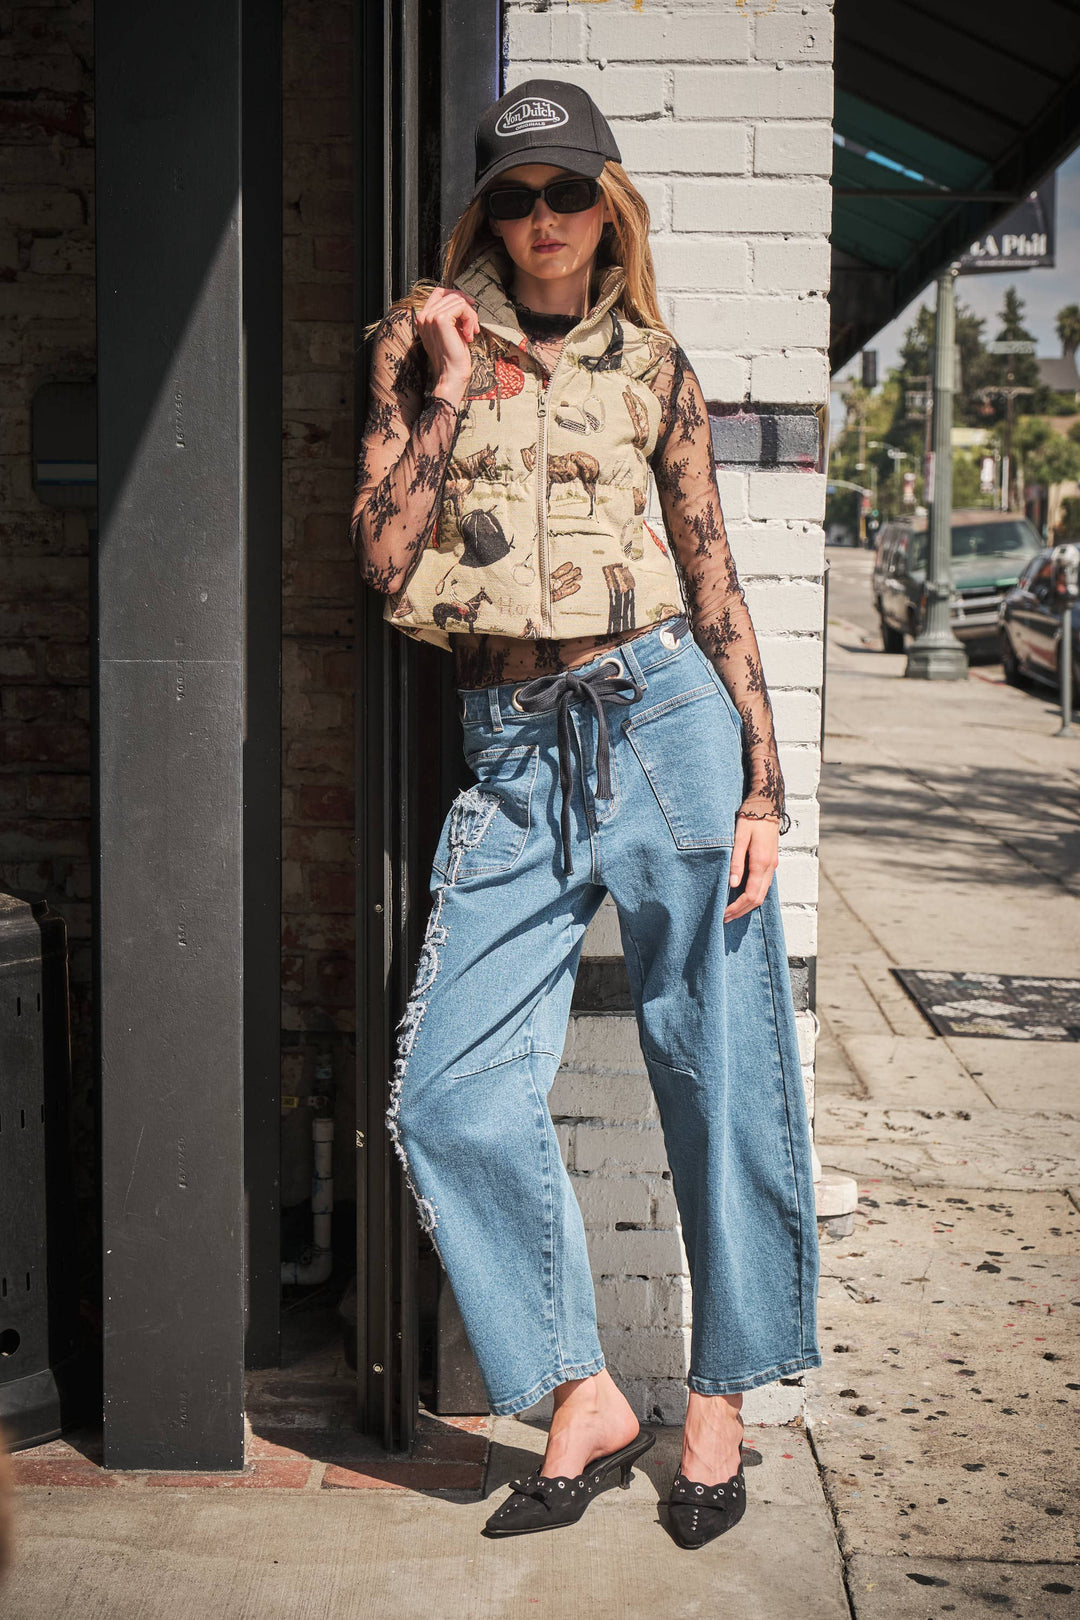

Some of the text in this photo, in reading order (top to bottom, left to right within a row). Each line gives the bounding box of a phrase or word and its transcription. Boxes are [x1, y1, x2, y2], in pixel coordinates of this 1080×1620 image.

[503, 102, 556, 125] Von Dutch
[1002, 233, 1047, 256] Phil
